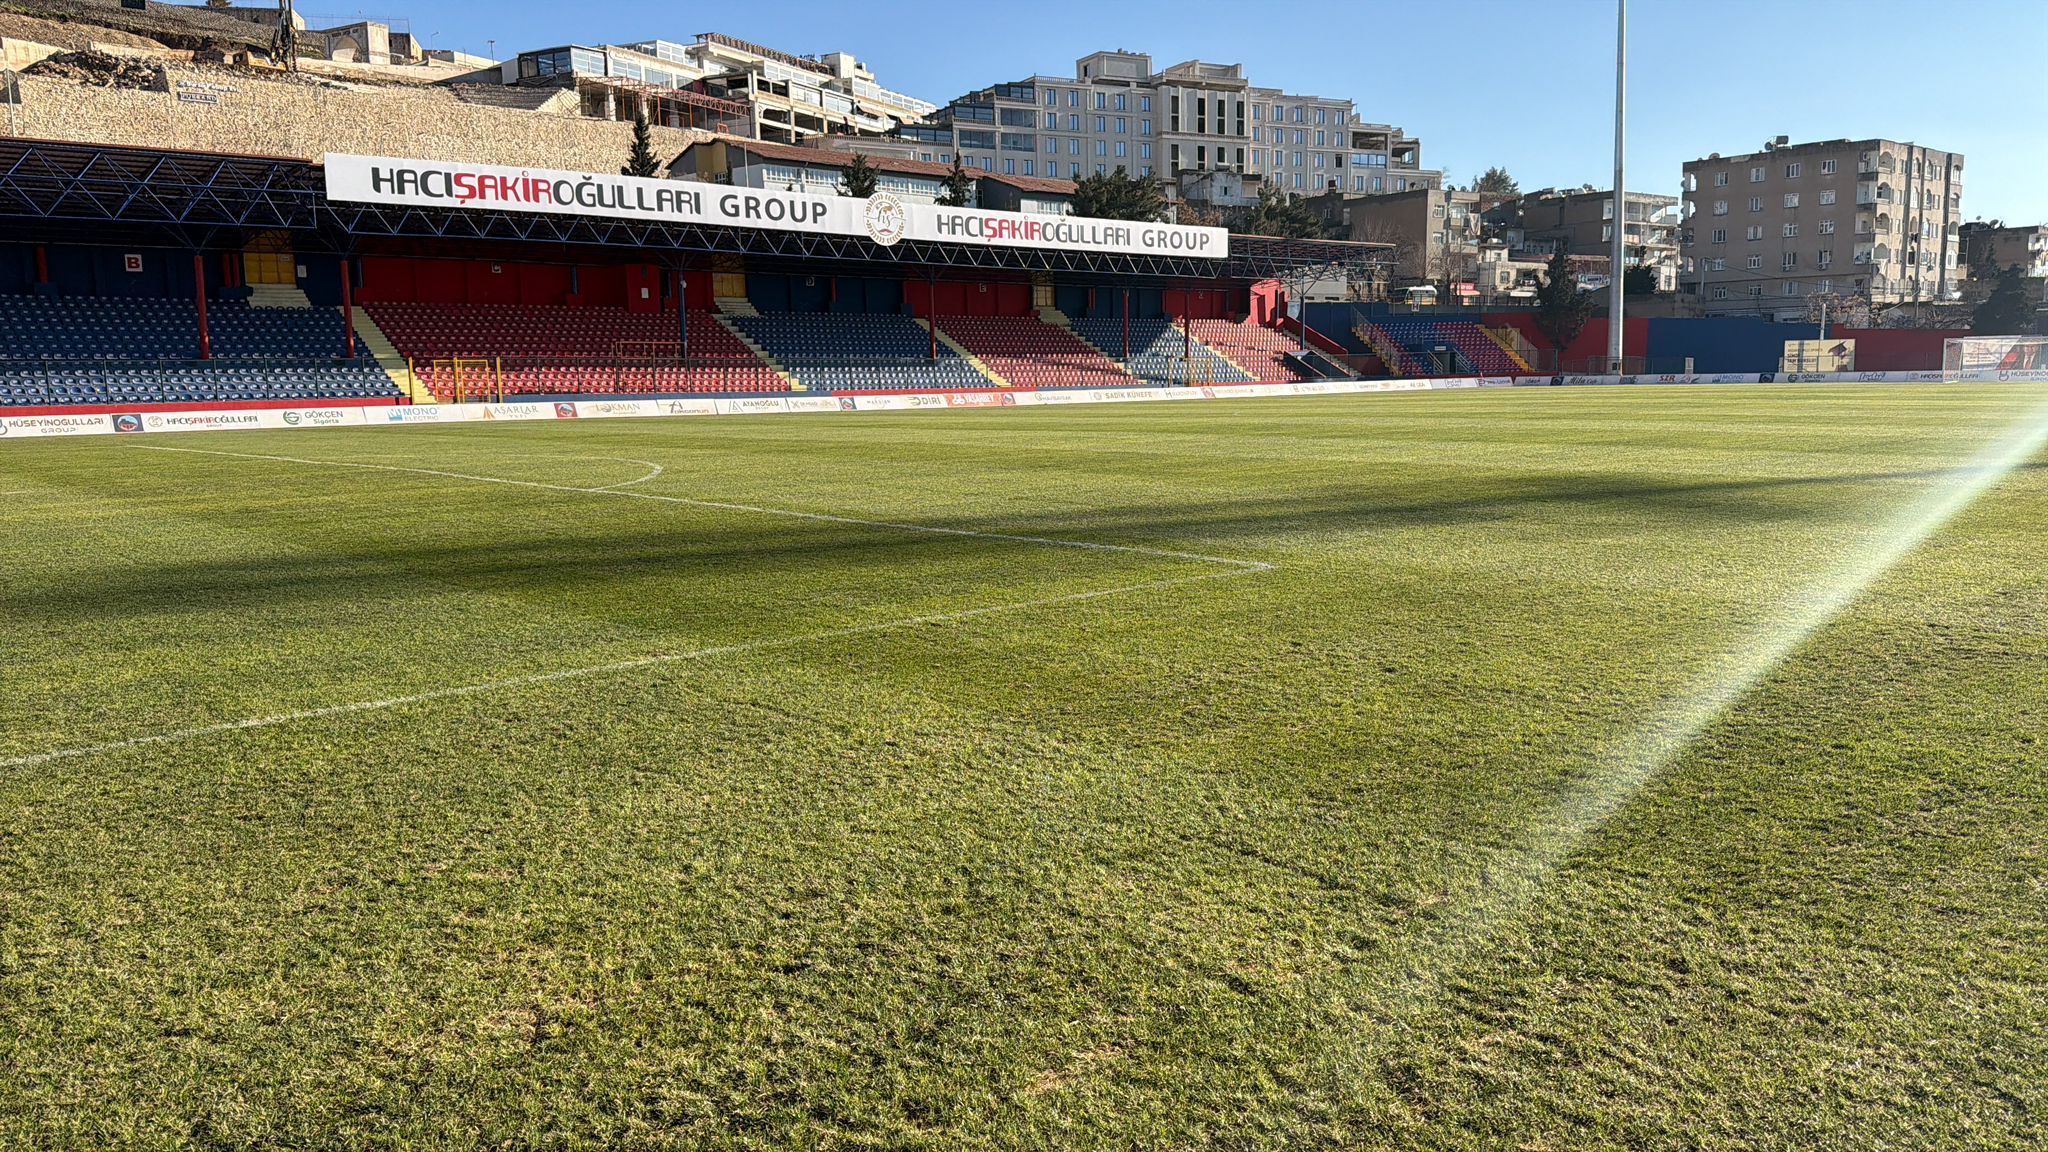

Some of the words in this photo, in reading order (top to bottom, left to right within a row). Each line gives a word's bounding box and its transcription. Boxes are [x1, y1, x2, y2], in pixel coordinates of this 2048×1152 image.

[371, 167, 700, 215] HACIŞAKİROĞULLARI
[719, 194, 828, 225] GROUP
[936, 214, 1131, 246] HACIŞAKİROĞULLARI
[1142, 229, 1211, 251] GROUP
[127, 256, 140, 269] B
[304, 410, 344, 419] GÖKÇEN
[403, 406, 438, 416] MONO
